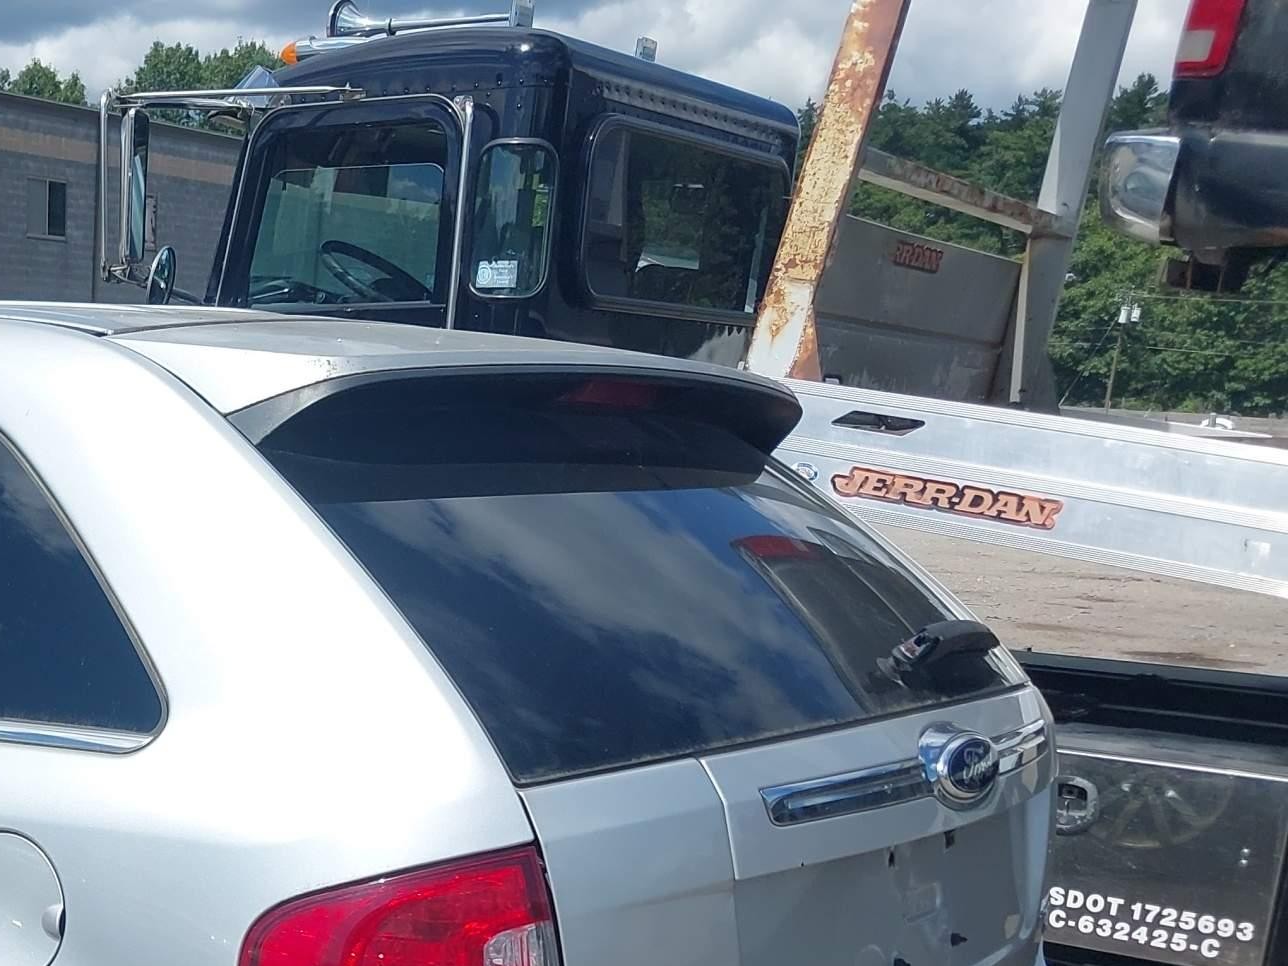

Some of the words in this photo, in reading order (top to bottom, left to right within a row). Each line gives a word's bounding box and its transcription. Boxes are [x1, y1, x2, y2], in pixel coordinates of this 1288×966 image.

[832, 467, 1063, 528] JERR-DAN
[959, 743, 995, 787] Ford
[1130, 902, 1255, 941] 1725693
